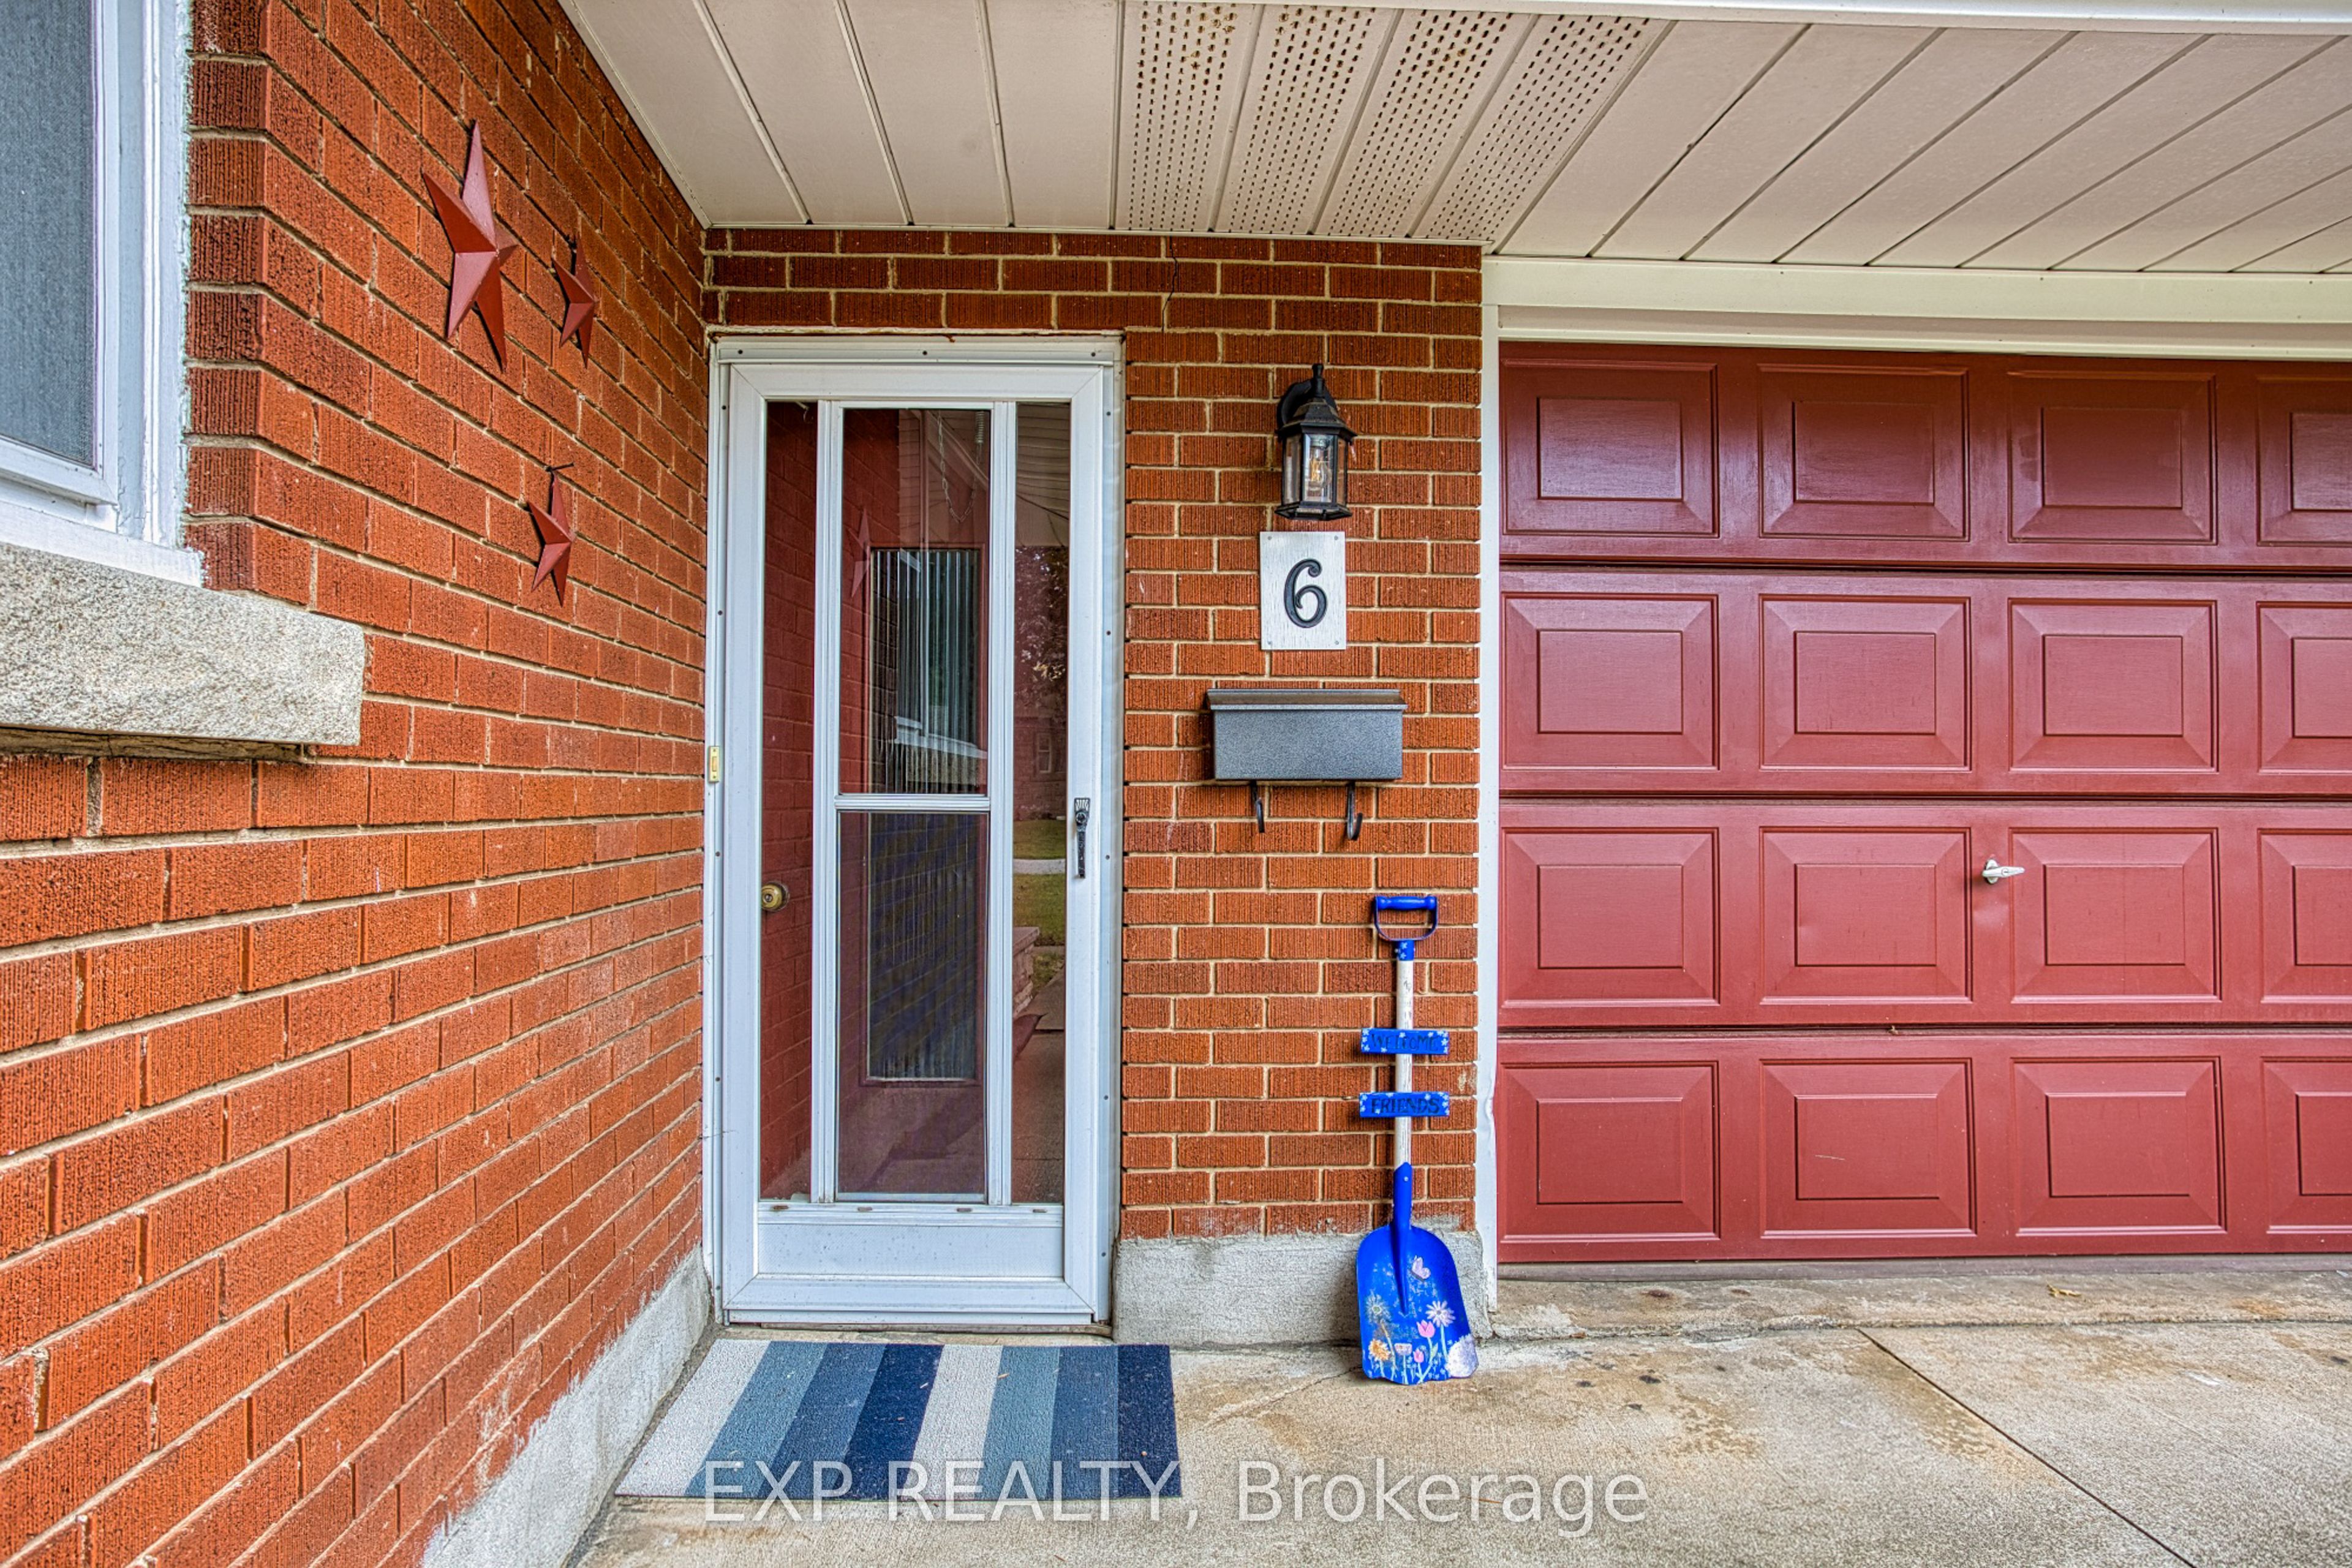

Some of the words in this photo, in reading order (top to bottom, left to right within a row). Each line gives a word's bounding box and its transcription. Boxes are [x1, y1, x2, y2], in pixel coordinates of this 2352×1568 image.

[1284, 558, 1328, 628] 6
[1371, 1033, 1439, 1052] WELCOME
[1371, 1098, 1440, 1114] FRIENDS
